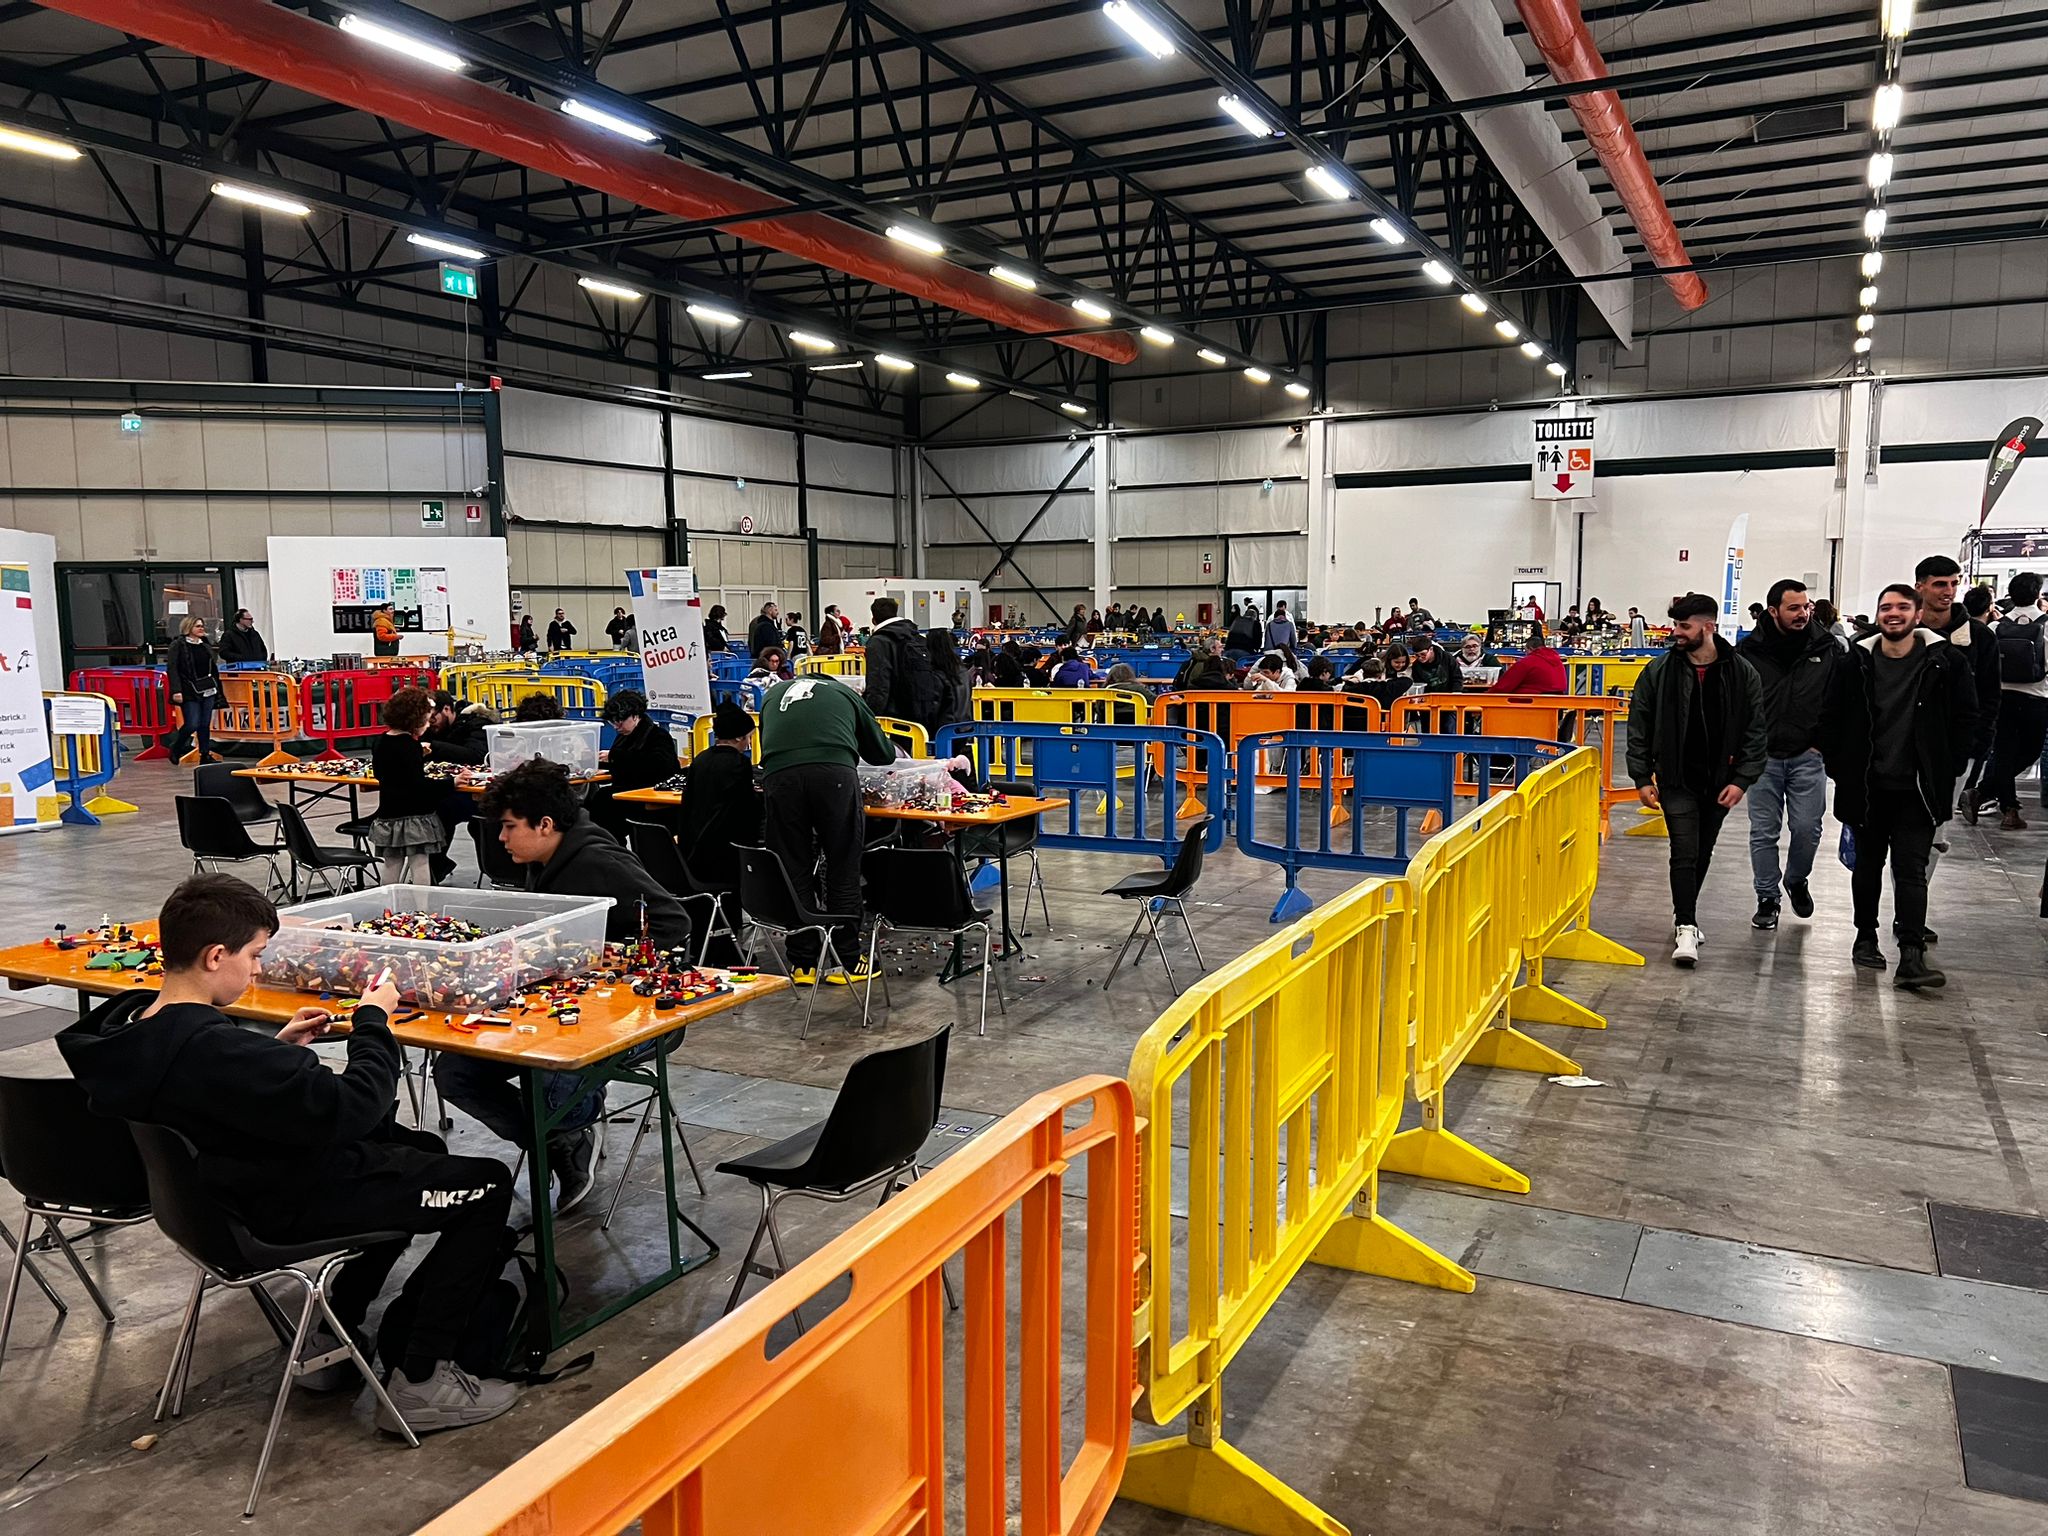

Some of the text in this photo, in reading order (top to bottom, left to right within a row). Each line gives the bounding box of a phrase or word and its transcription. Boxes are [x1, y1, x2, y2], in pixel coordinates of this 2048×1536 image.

[1537, 421, 1593, 438] TOILETTE
[2012, 425, 2030, 449] CARDS
[642, 626, 678, 649] Area
[644, 646, 686, 669] Gioco
[420, 1190, 469, 1208] NIKE
